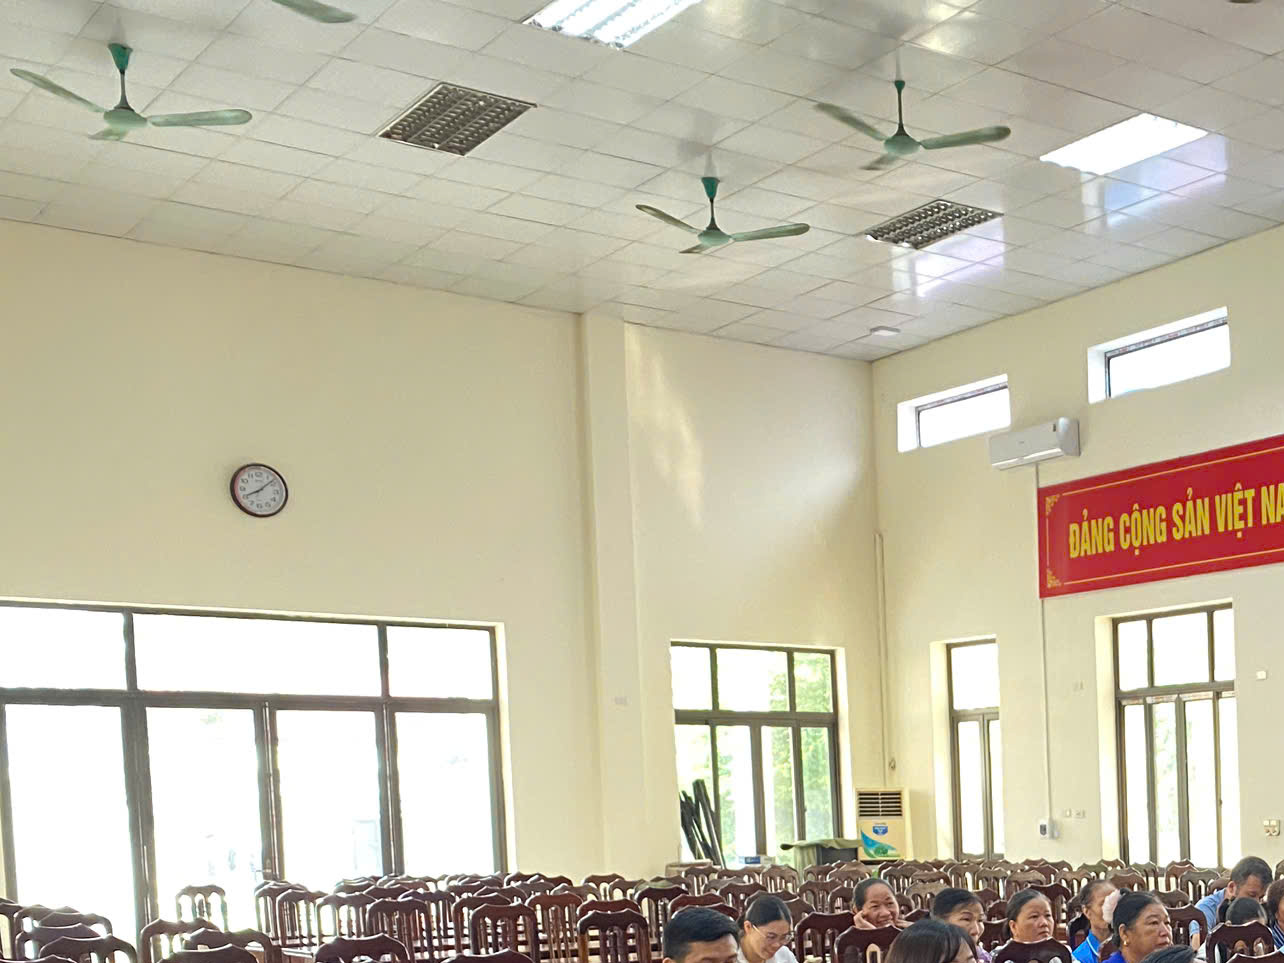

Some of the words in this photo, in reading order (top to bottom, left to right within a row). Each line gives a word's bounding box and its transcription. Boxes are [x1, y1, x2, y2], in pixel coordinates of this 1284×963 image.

[1068, 510, 1115, 558] ĐẢNG
[1119, 505, 1168, 556] CỘNG
[1171, 488, 1211, 541] SẢN
[1215, 483, 1256, 538] VIỆT
